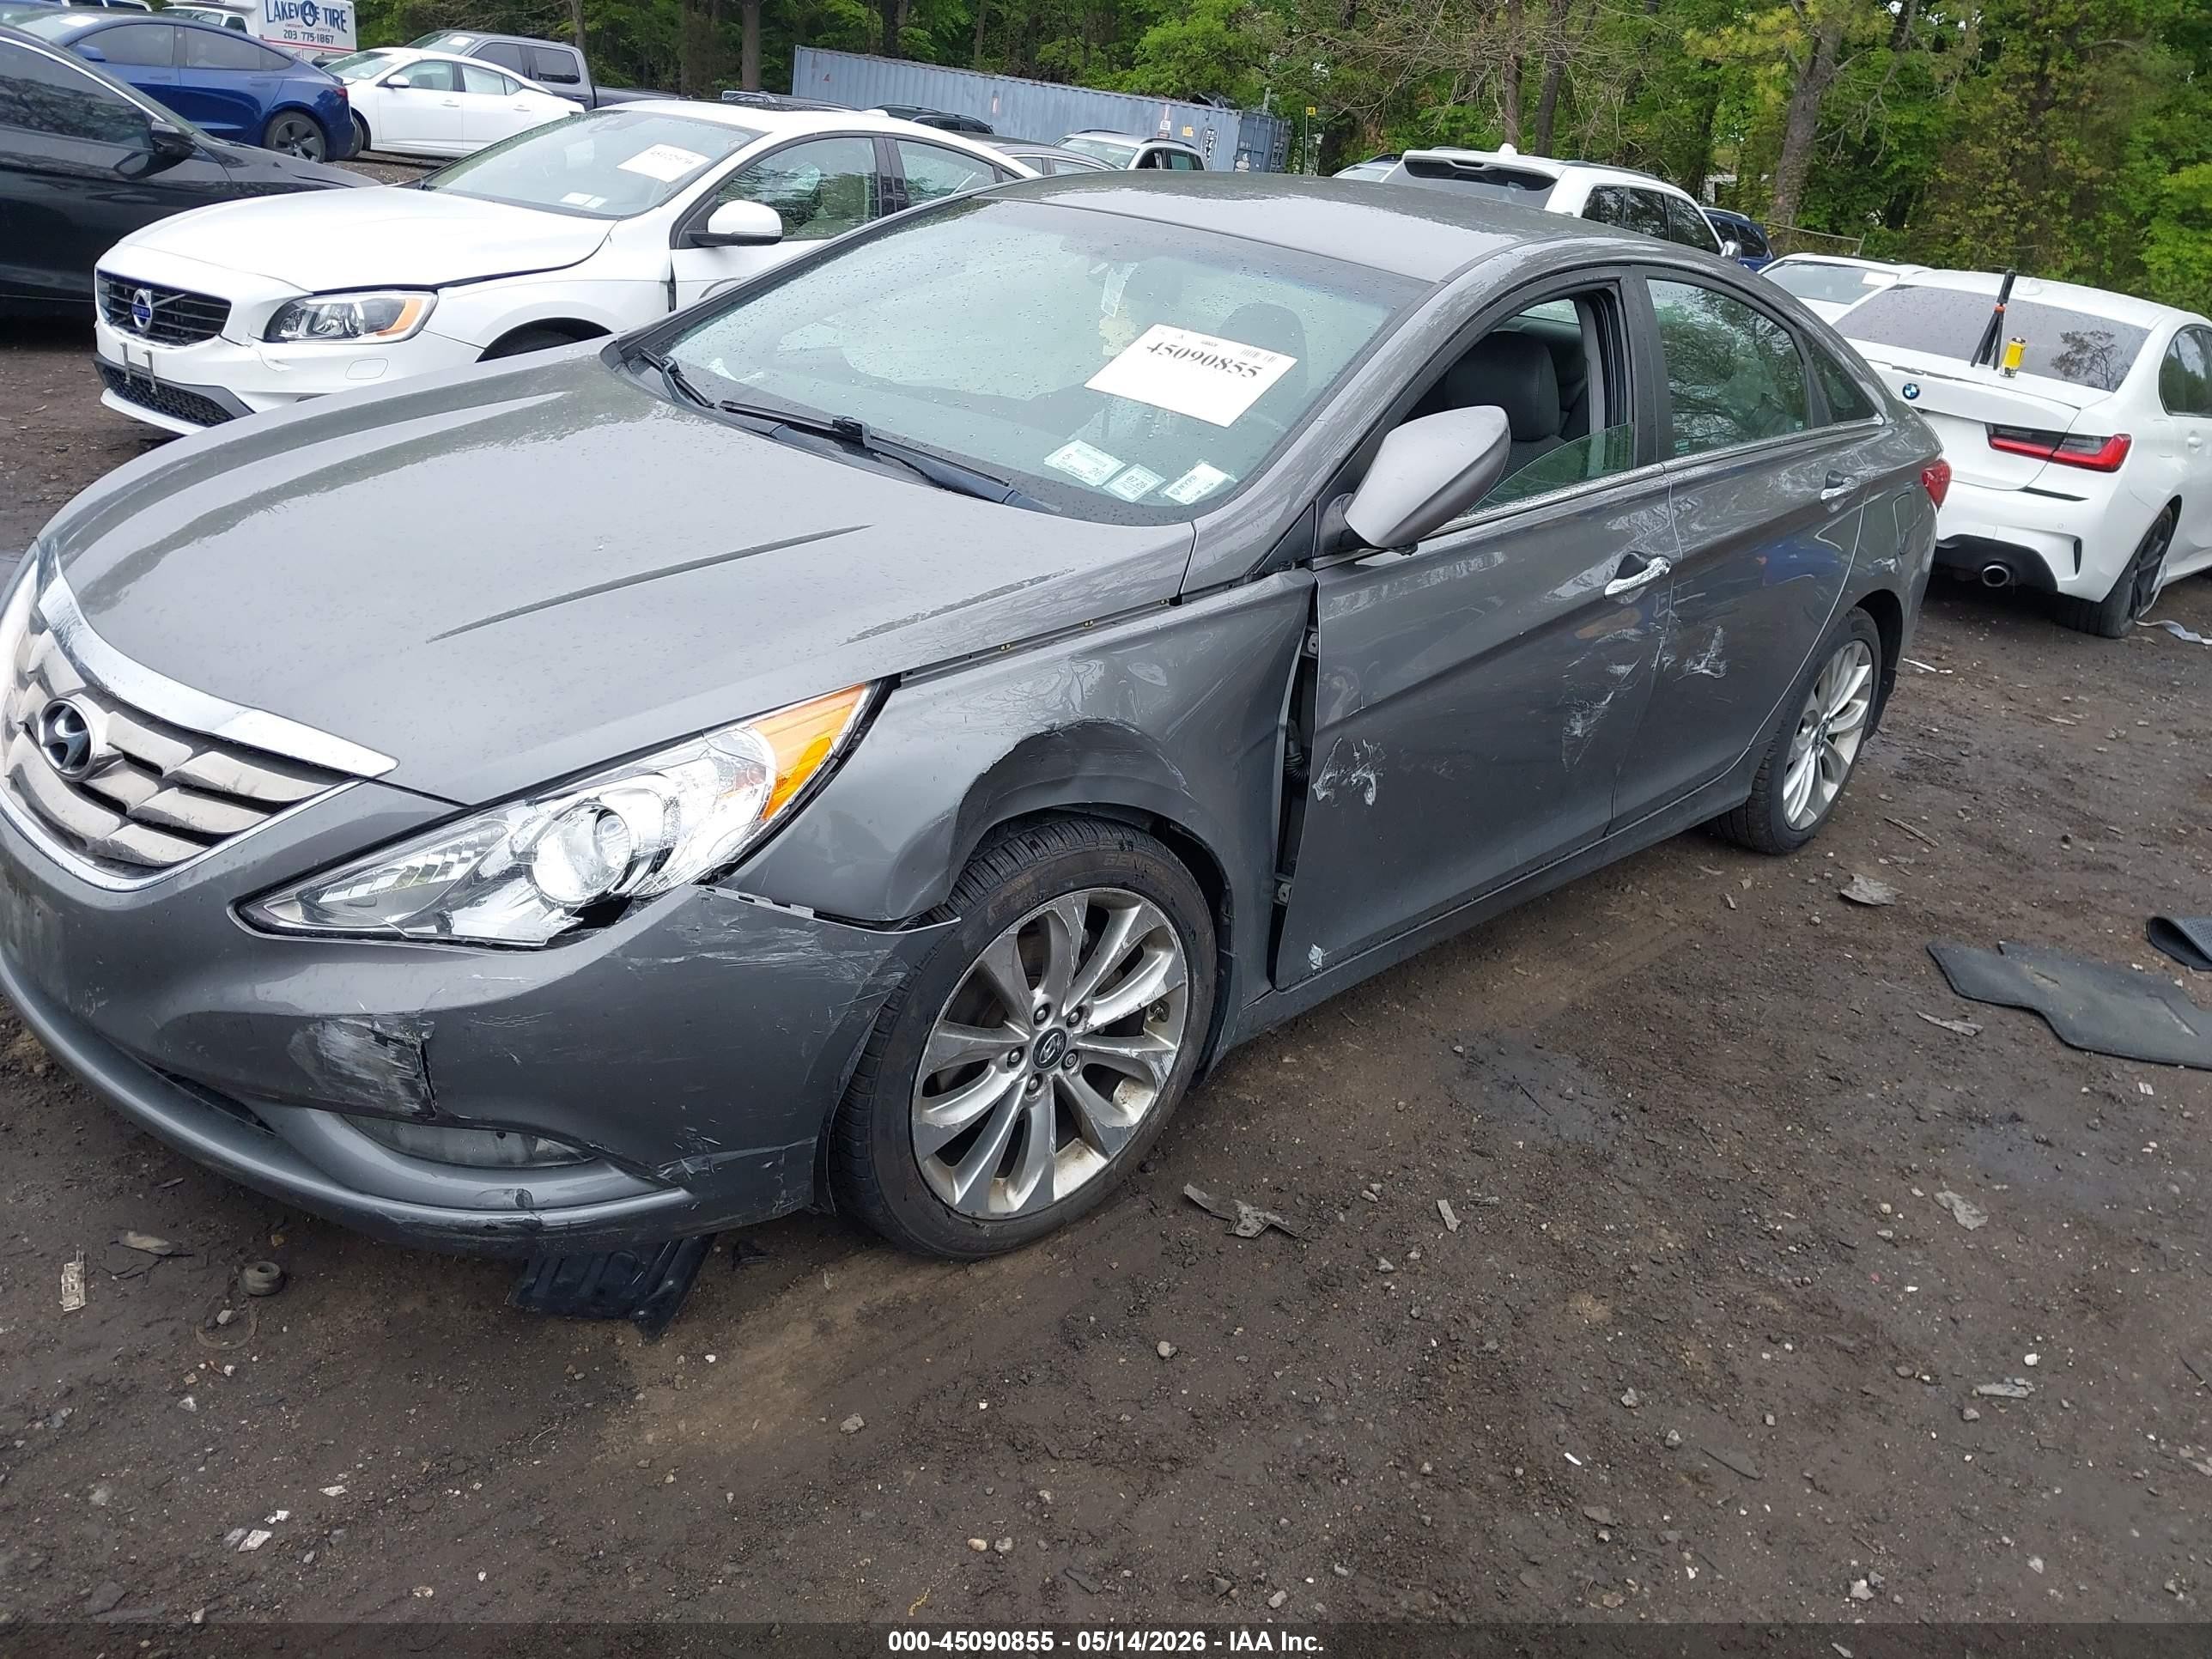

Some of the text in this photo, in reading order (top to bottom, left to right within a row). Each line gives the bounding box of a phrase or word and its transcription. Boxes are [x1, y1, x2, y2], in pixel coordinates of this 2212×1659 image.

[322, 7, 348, 33] TIRE
[283, 29, 298, 40] 203
[1146, 342, 1263, 379] 45090855
